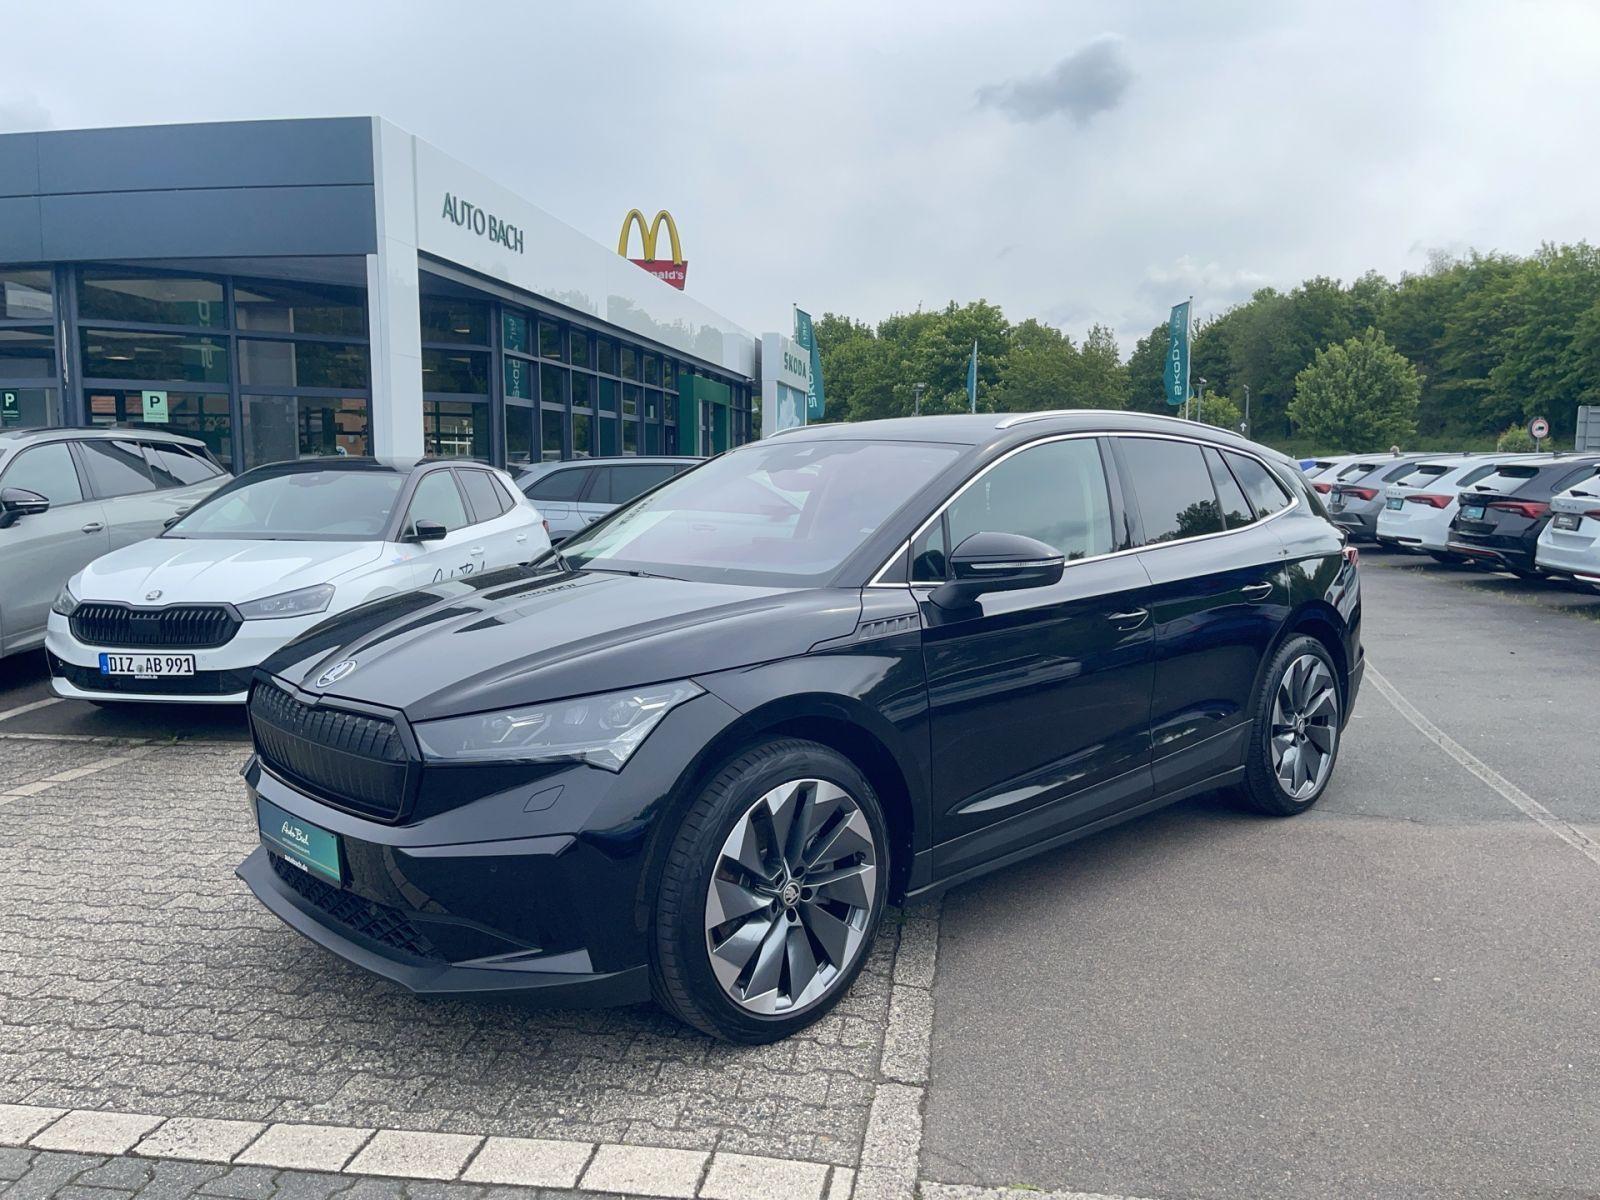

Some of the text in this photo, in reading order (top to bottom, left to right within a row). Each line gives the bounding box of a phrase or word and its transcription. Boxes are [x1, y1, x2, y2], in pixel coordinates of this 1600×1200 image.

[442, 192, 523, 254] AUTO BACH
[5, 393, 15, 407] P
[150, 395, 160, 408] P
[109, 657, 192, 673] DIZ AB 991
